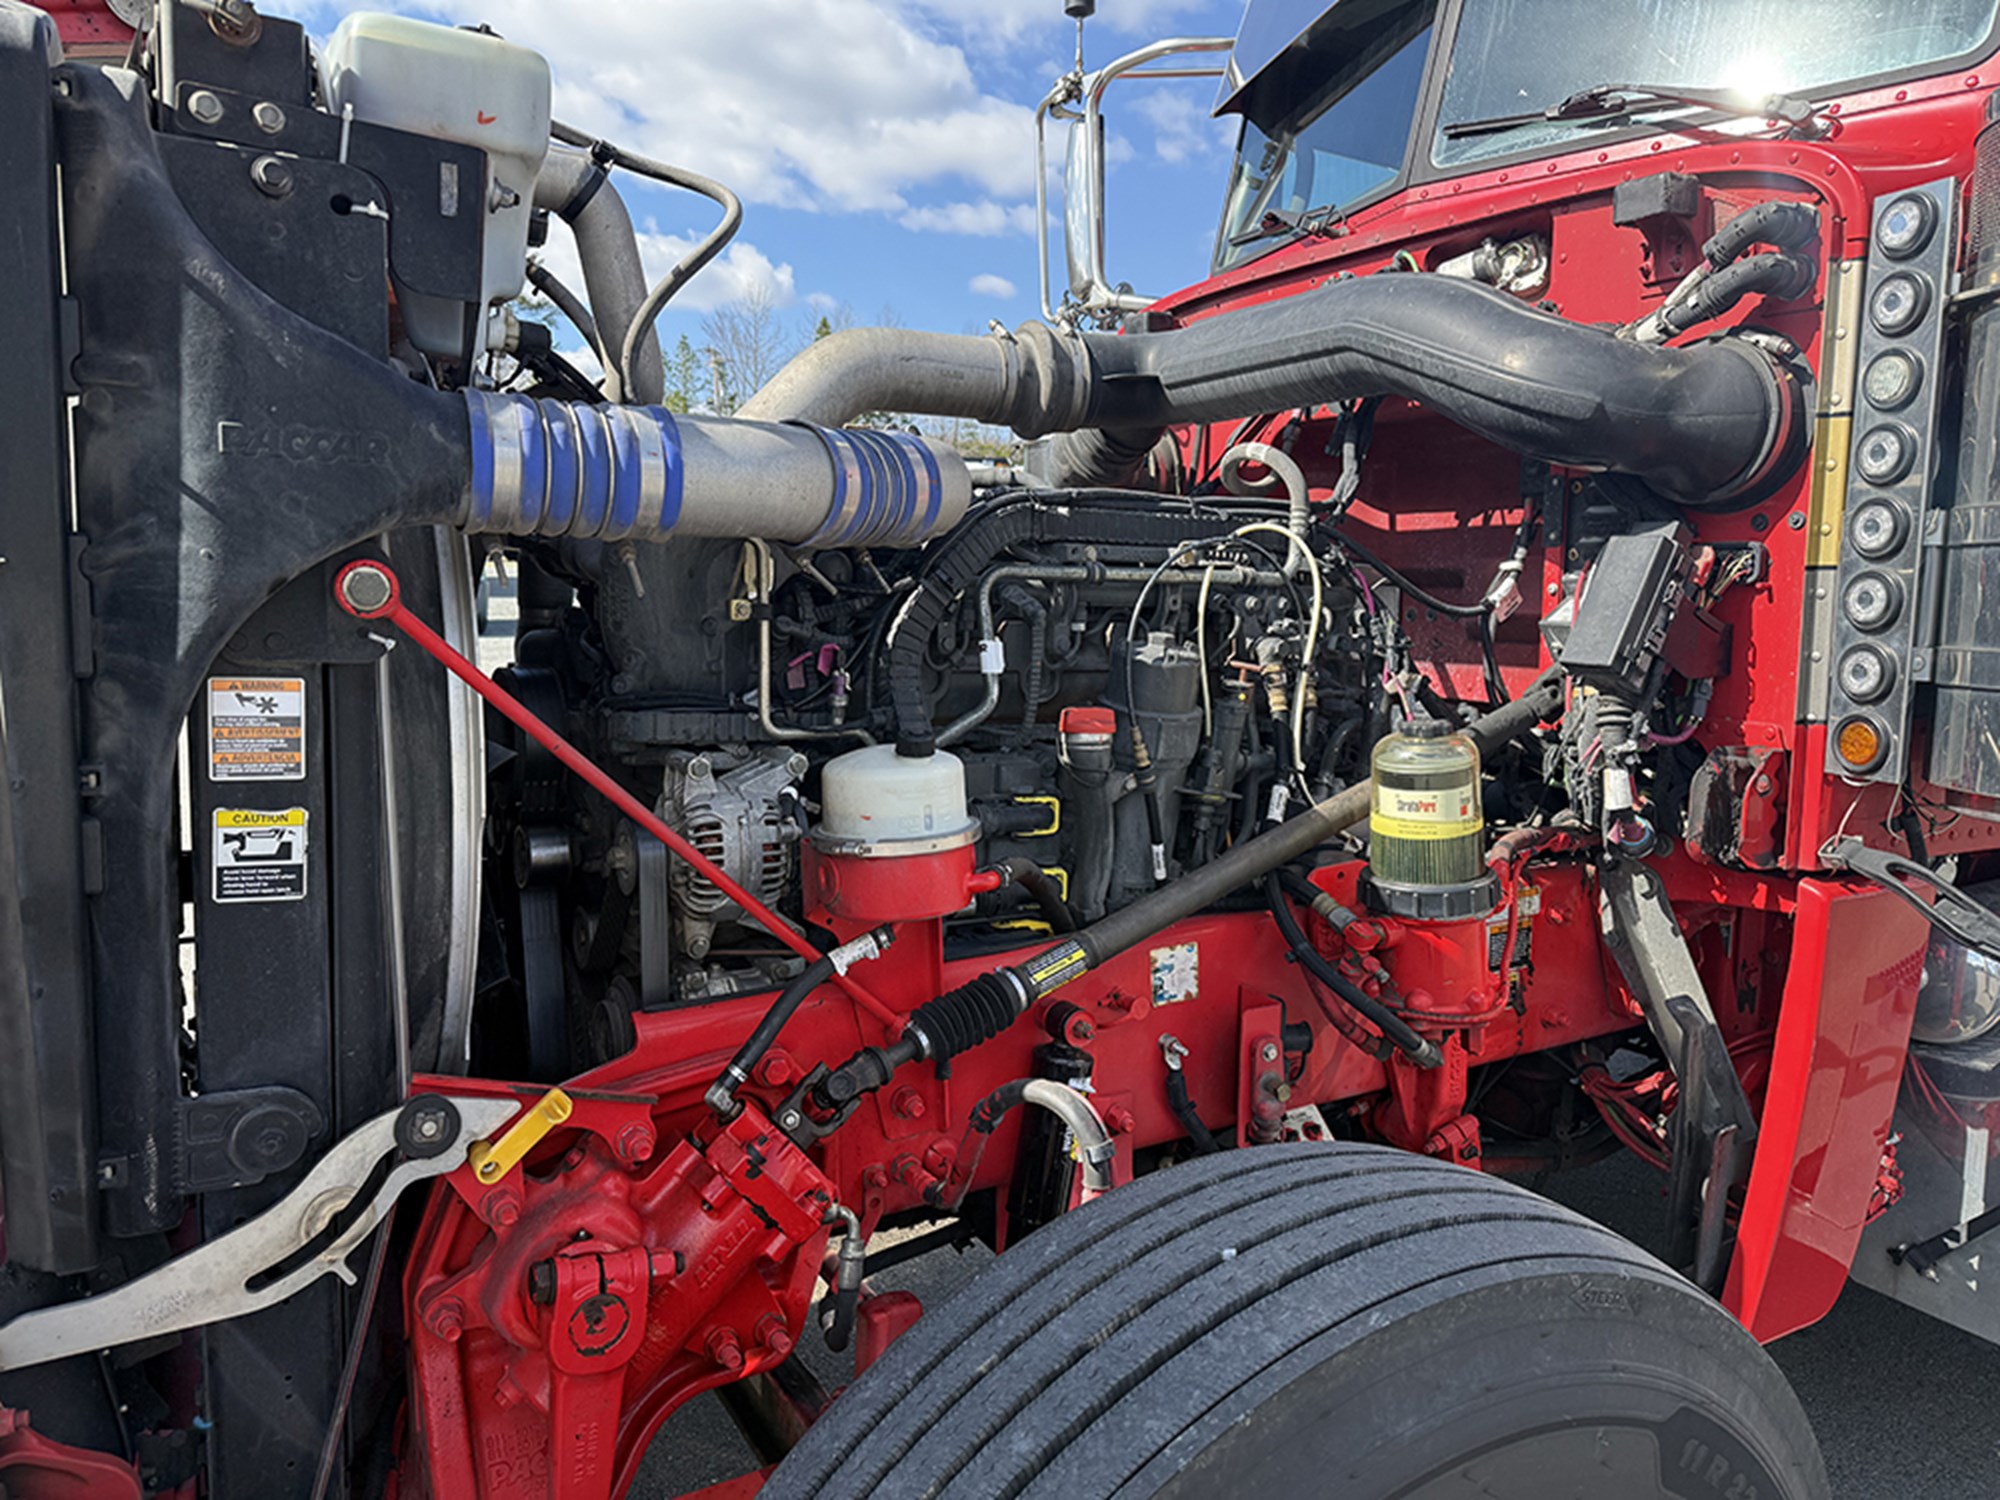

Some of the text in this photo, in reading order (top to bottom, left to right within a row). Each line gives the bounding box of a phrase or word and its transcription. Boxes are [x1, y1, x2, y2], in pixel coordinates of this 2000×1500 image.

[217, 421, 392, 464] PACCAR
[241, 681, 285, 690] WARNING
[228, 729, 299, 737] AVERTISSEMENT
[232, 754, 296, 762] ADVERTENCIA
[232, 813, 289, 824] CAUTION
